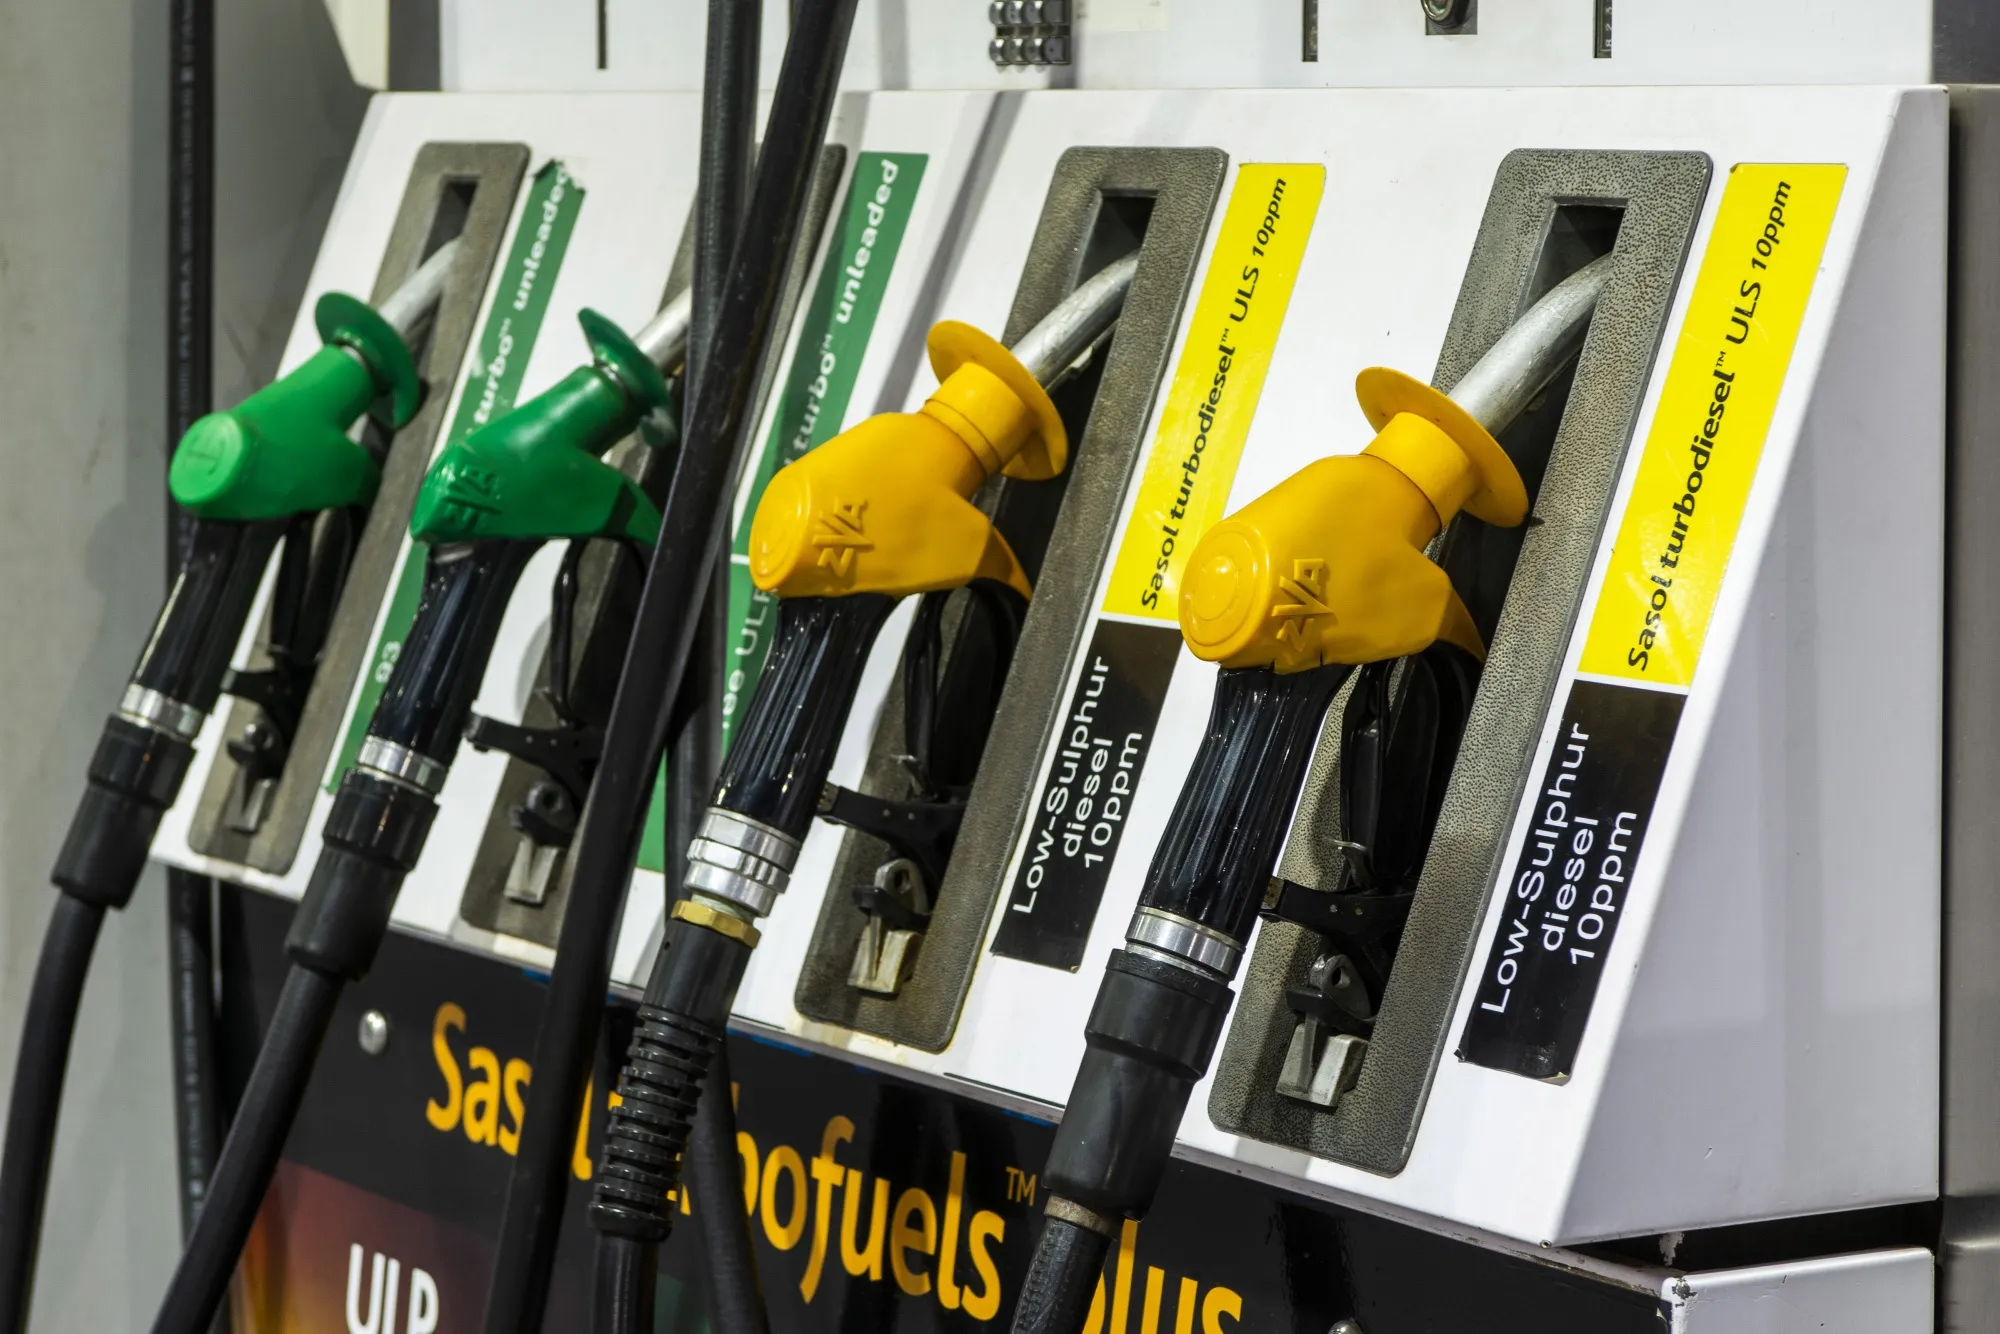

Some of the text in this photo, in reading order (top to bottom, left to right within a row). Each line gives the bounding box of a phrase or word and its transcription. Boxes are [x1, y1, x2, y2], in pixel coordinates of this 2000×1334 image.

[836, 158, 899, 325] unleaded
[1141, 524, 1179, 610] Sasol
[1229, 265, 1259, 323] ULS
[1252, 178, 1287, 257] 10ppm
[1627, 574, 1673, 672] Sasol
[1725, 279, 1761, 345] ULS
[1751, 180, 1792, 271] 10ppm
[1271, 558, 1334, 653] ZVA
[1012, 655, 1109, 914] Low-Sulphur
[1063, 737, 1113, 858] diesel
[1084, 731, 1143, 868] 10ppm
[1481, 722, 1590, 1015] Low-Sulphur
[1542, 815, 1599, 952] diesel
[1569, 811, 1637, 965] 10ppm
